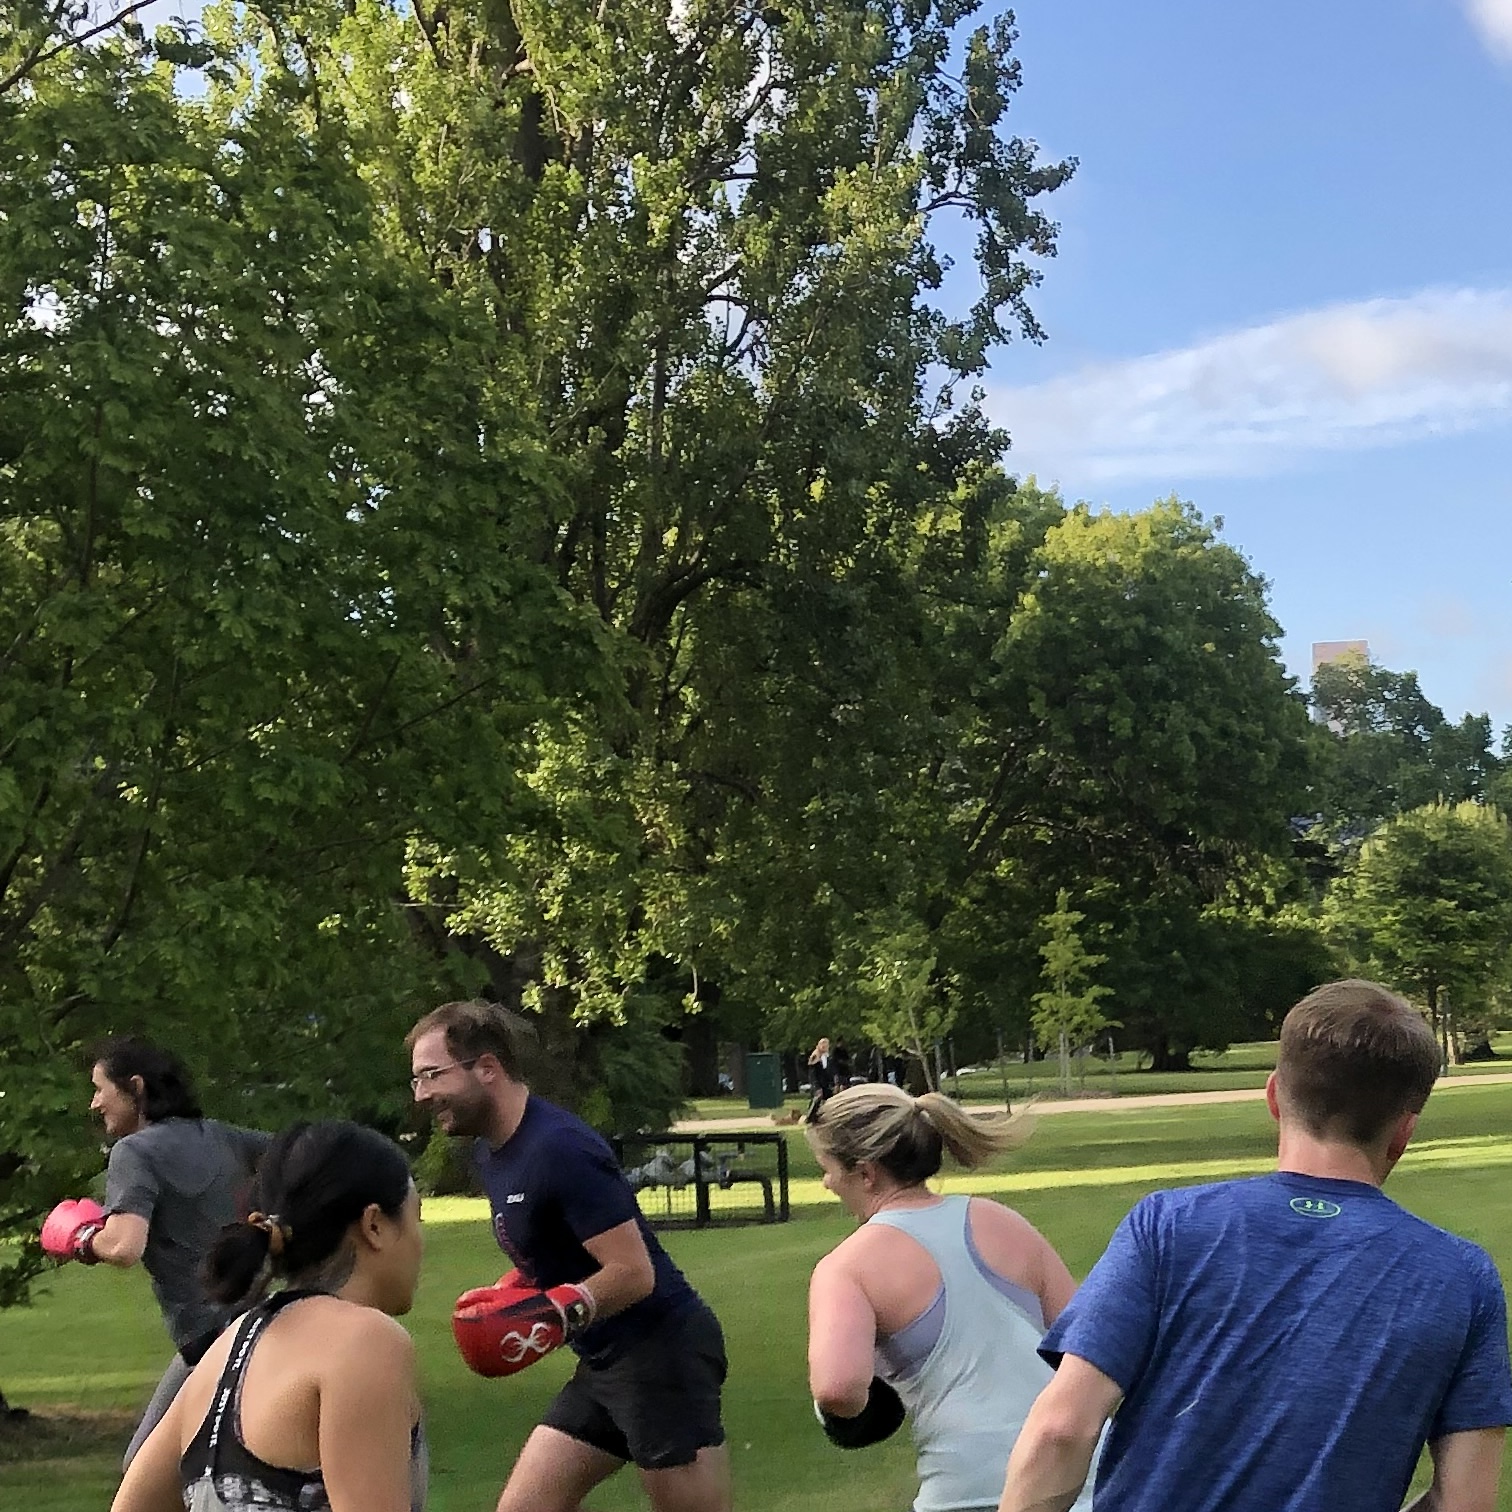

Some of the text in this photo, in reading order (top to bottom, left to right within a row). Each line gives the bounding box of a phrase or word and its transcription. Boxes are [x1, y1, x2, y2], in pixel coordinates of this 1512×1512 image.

[238, 1341, 250, 1357] DO
[217, 1387, 231, 1413] JUST
[213, 1414, 222, 1432] DO
